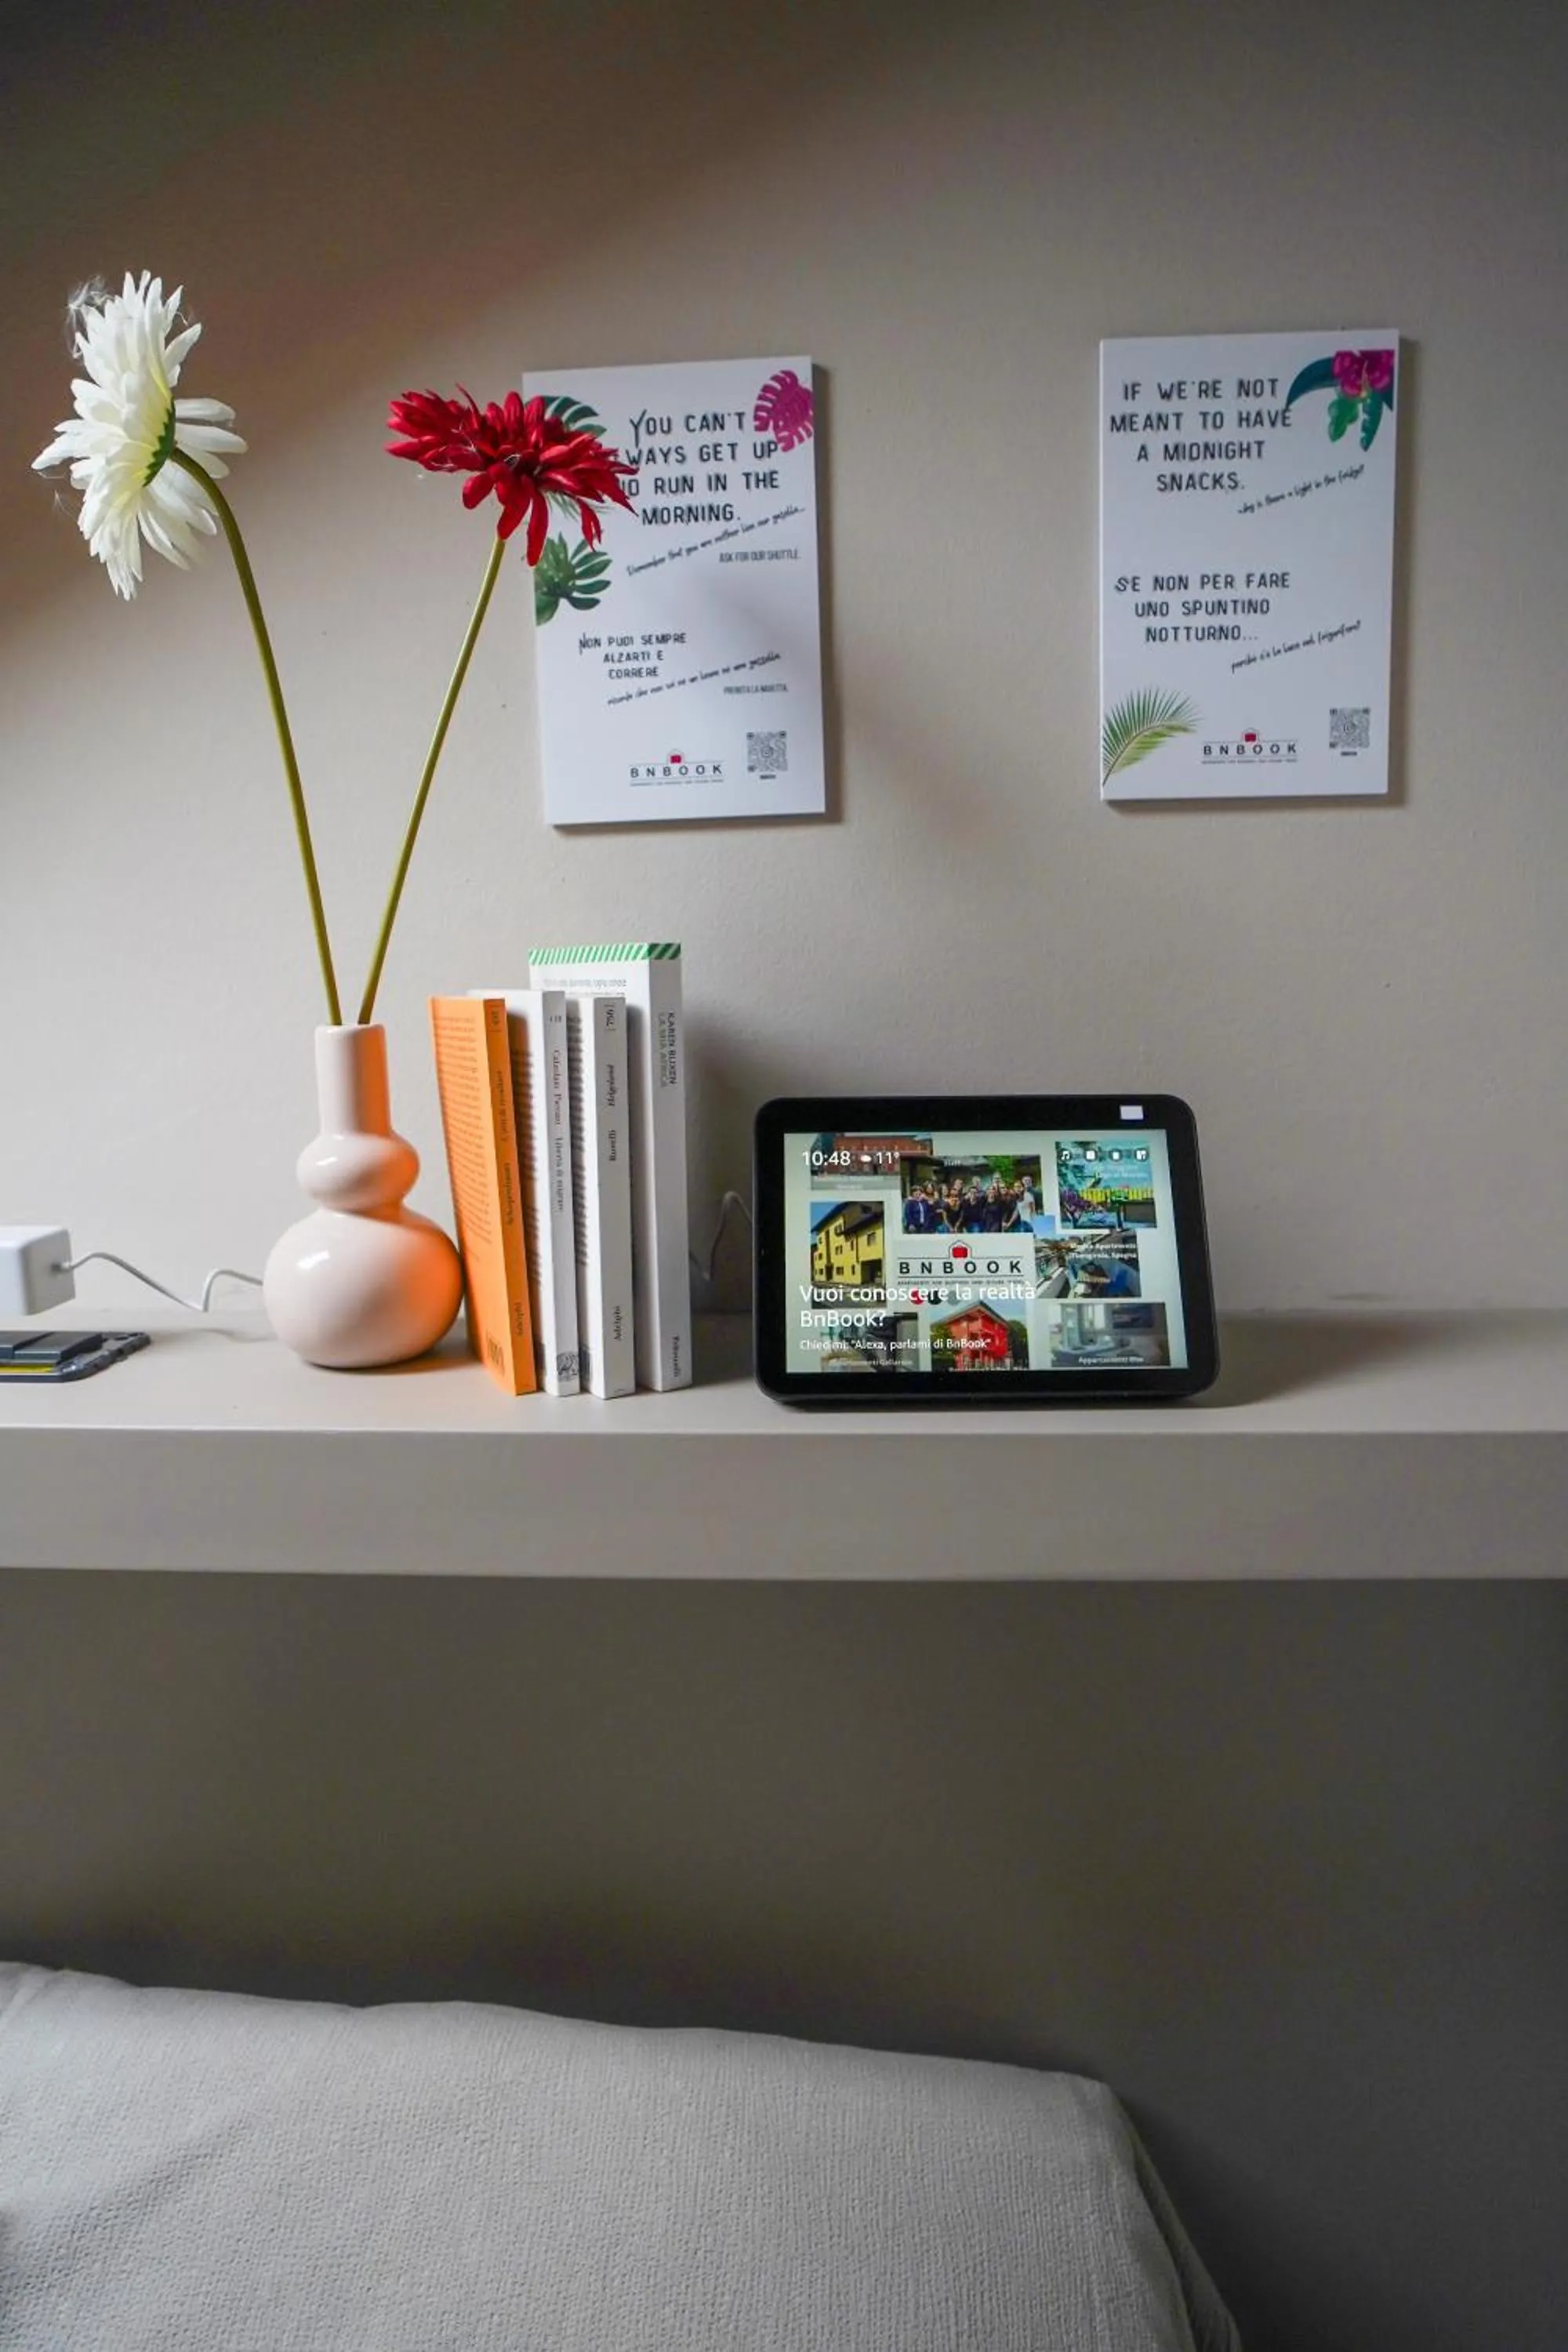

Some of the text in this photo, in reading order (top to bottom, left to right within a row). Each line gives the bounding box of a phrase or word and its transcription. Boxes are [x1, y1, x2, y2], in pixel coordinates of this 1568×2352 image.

[1123, 378, 1279, 402] IF WE'RE NOT
[630, 409, 746, 448] YOU CAN'T
[1110, 408, 1293, 433] MEANT TO HAVE
[625, 440, 779, 466] WAYS GET UP
[1137, 440, 1265, 463] A MIDNIGHT
[655, 476, 695, 495] RUN
[707, 474, 728, 492] IN
[742, 470, 780, 490] THE
[1156, 471, 1246, 492] SNACKS.
[641, 503, 740, 526] MORNING.
[1114, 572, 1290, 593] SE NON PER FARE
[1134, 598, 1271, 618] UNO SPUNTINO
[579, 633, 601, 656] NON
[641, 633, 687, 645] SEMPRE
[603, 650, 664, 663] ALZARTI E
[608, 666, 659, 680] CORRERE
[667, 1011, 677, 1047] KAREN
[802, 1150, 901, 1166] 10:48 11°
[800, 1283, 1036, 1302] Vuoi conoscere la realtà
[800, 1310, 886, 1328] BnBook?
[890, 1338, 931, 1352] parlami
[934, 1338, 943, 1348] di
